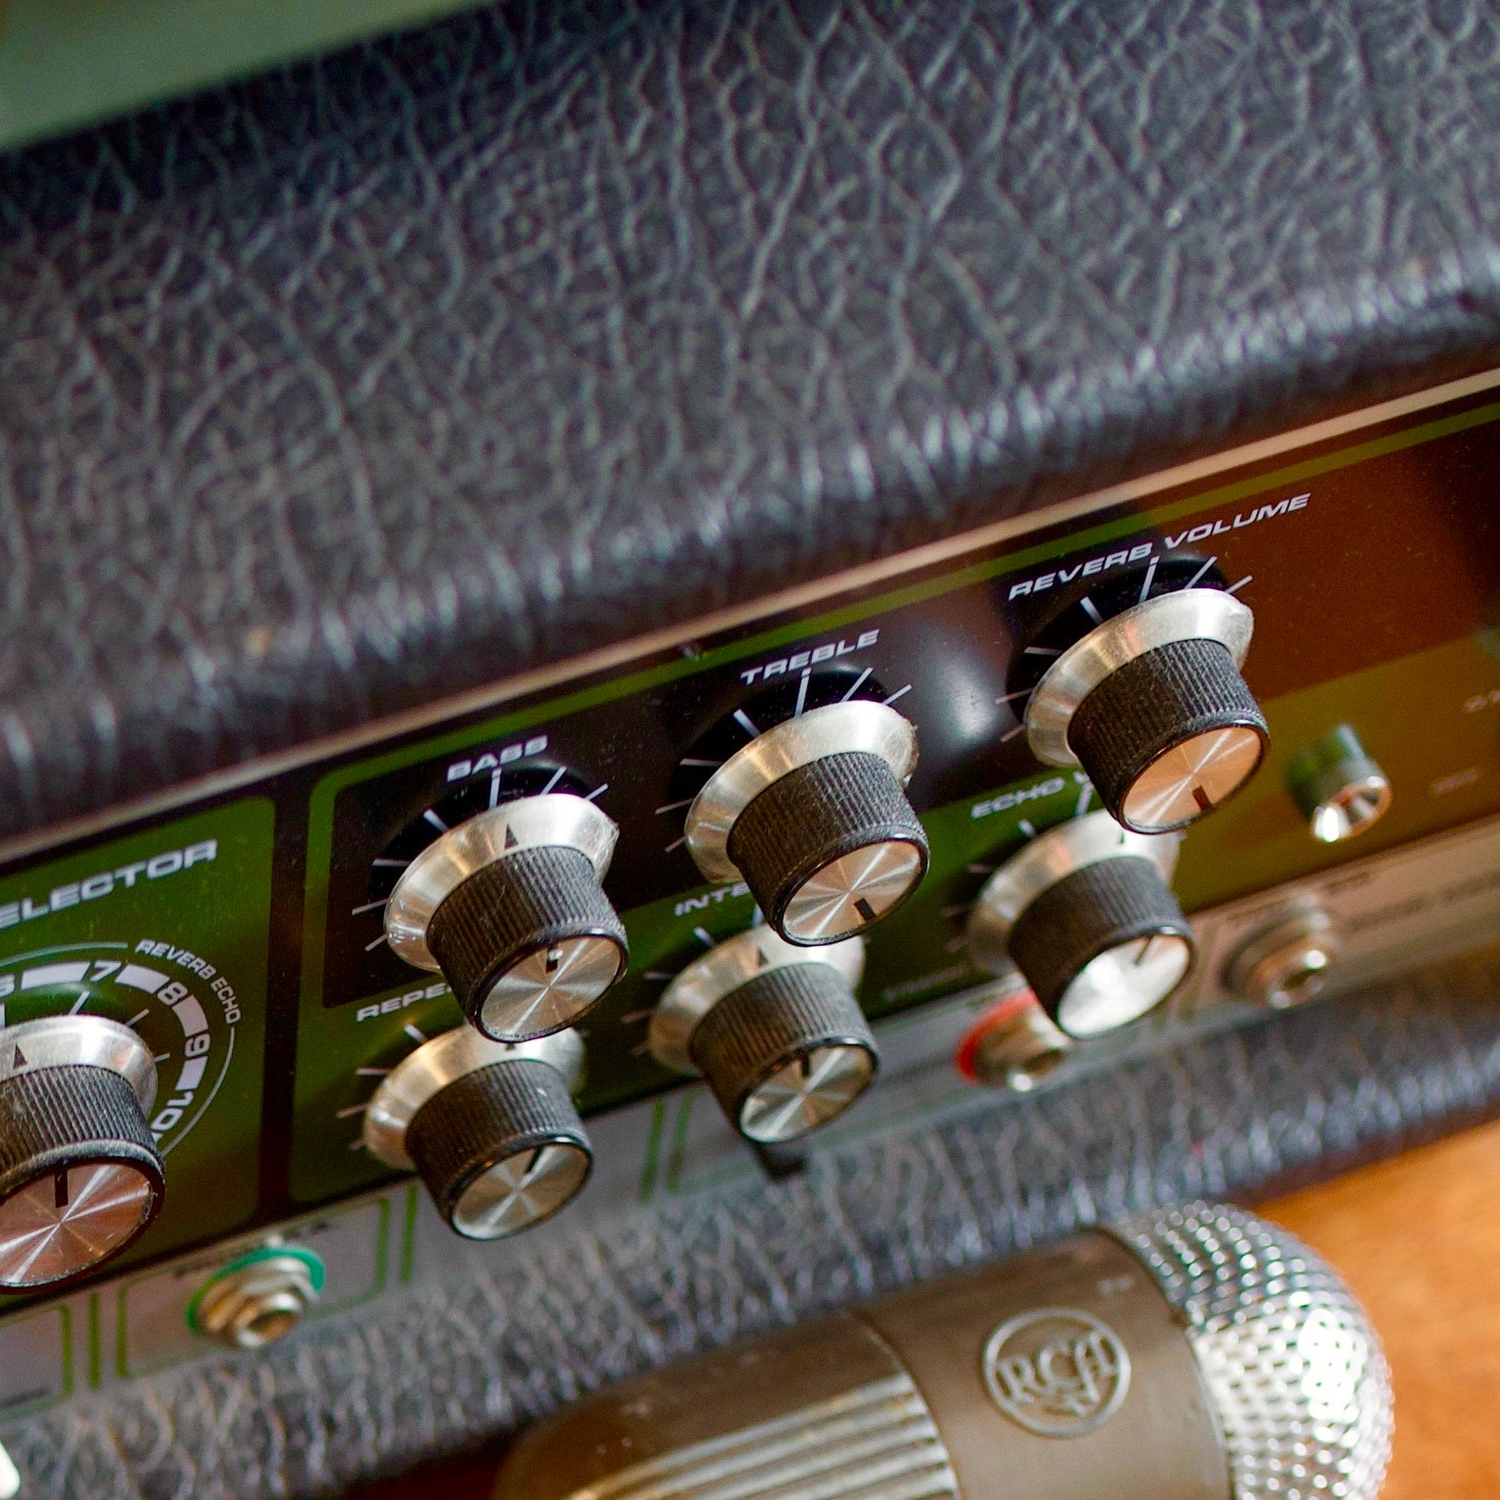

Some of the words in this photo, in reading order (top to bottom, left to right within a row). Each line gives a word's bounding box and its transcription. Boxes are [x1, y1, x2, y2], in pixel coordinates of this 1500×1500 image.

[1008, 541, 1153, 599] REVERB
[1164, 493, 1311, 550] VOLUME
[741, 629, 880, 686] TREBLE
[446, 735, 549, 783] BASS
[971, 777, 1066, 819] ECHO
[674, 882, 751, 917] INTE
[90, 960, 122, 982] 7
[135, 939, 217, 980] REVERB
[210, 976, 241, 1024] ECHO
[157, 981, 188, 1015] 8
[356, 982, 452, 1022] REPE
[185, 1033, 211, 1058] 9
[151, 1091, 194, 1131] 10
[996, 1331, 1122, 1404] RCA
